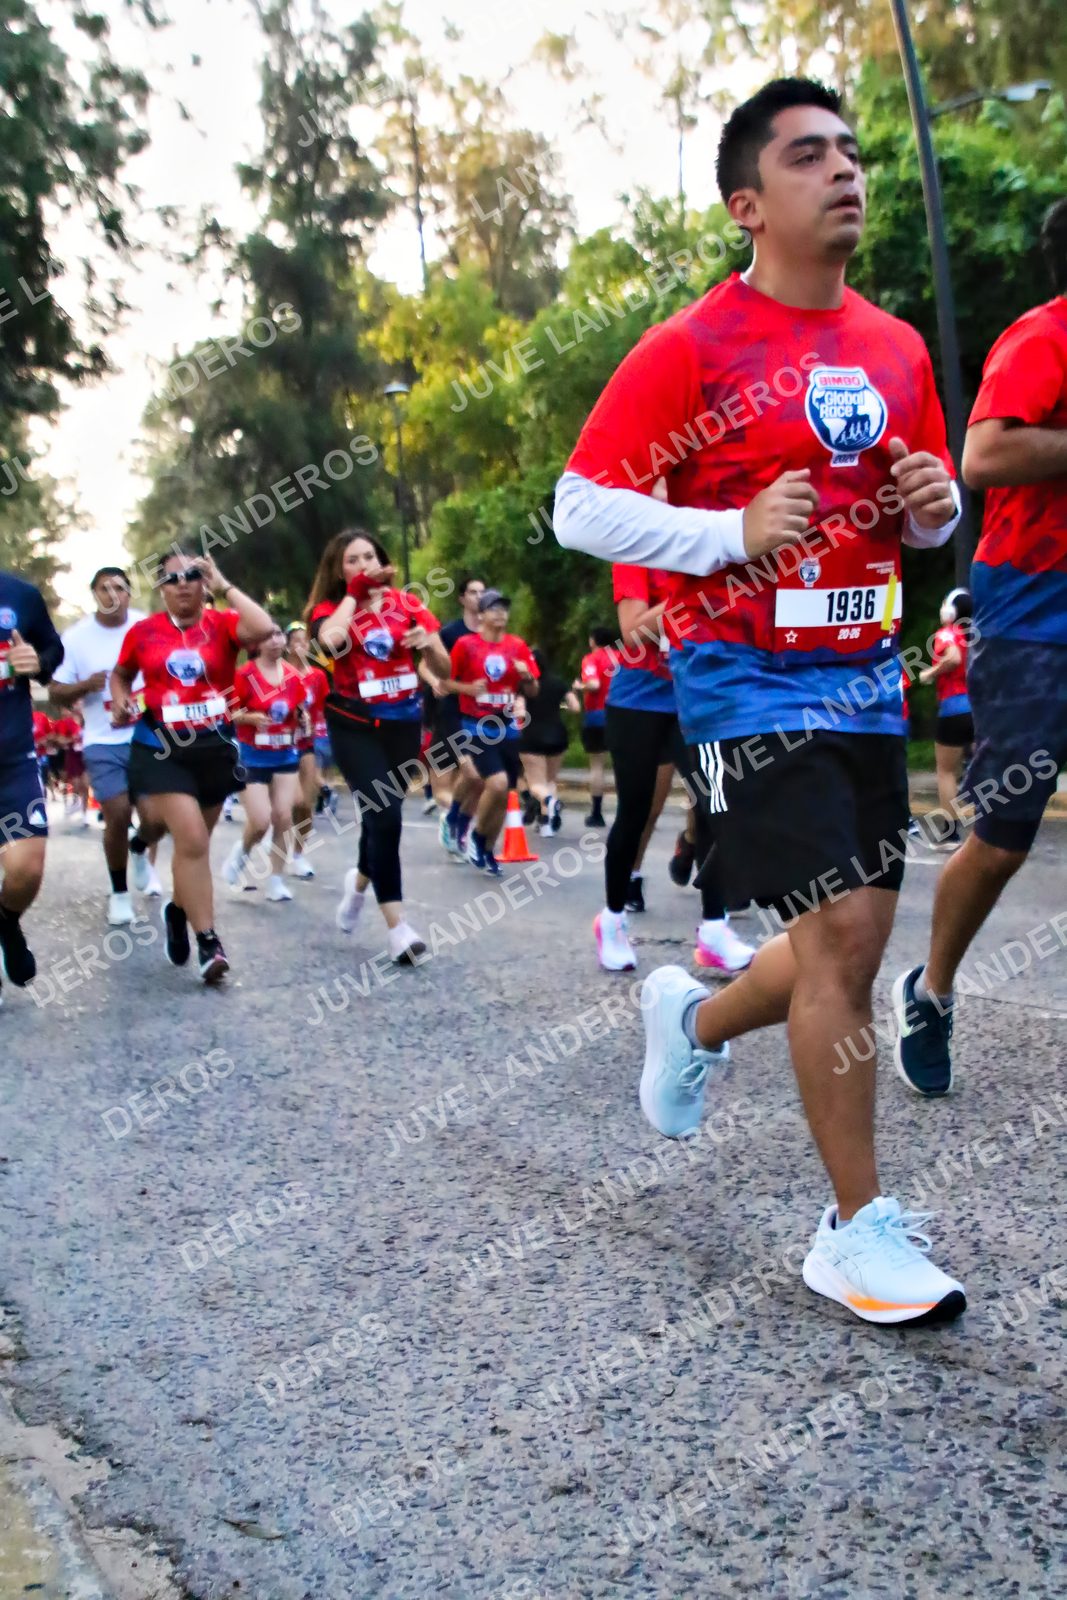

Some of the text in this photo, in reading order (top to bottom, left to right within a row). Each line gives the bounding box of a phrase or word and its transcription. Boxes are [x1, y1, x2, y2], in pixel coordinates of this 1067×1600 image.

[819, 376, 861, 386] BIMBO
[824, 391, 865, 406] Global
[819, 404, 854, 419] Race
[826, 588, 876, 624] 1936
